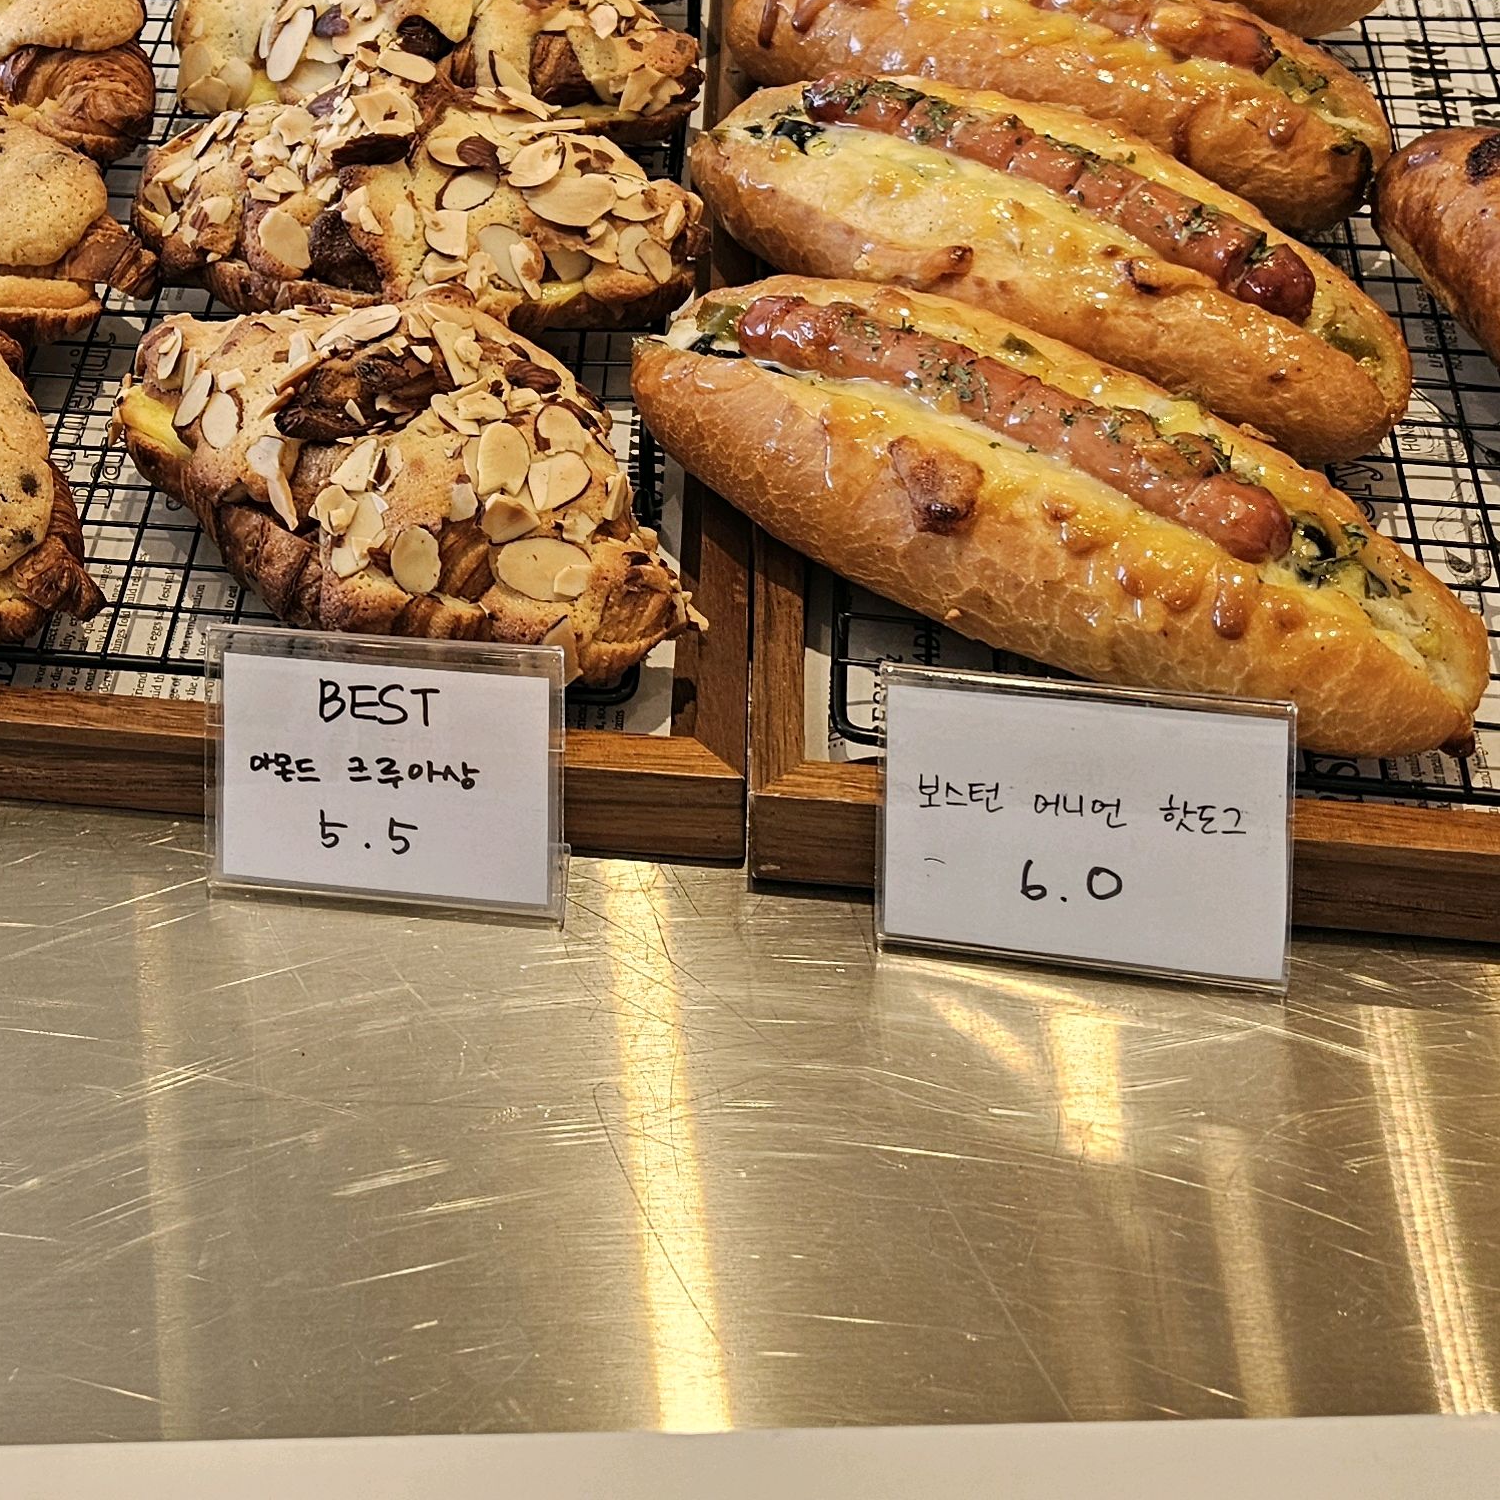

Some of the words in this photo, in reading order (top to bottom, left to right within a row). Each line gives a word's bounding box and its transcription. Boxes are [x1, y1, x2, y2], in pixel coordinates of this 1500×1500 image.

[317, 678, 441, 727] BEST
[249, 751, 322, 783] 아몬드
[347, 755, 481, 791] 크루아상
[918, 772, 1004, 814] 보스턴
[1033, 793, 1128, 830] 어니언
[1158, 793, 1247, 835] 핫도그
[319, 809, 419, 856] 5.5
[1020, 858, 1124, 904] 6.0
